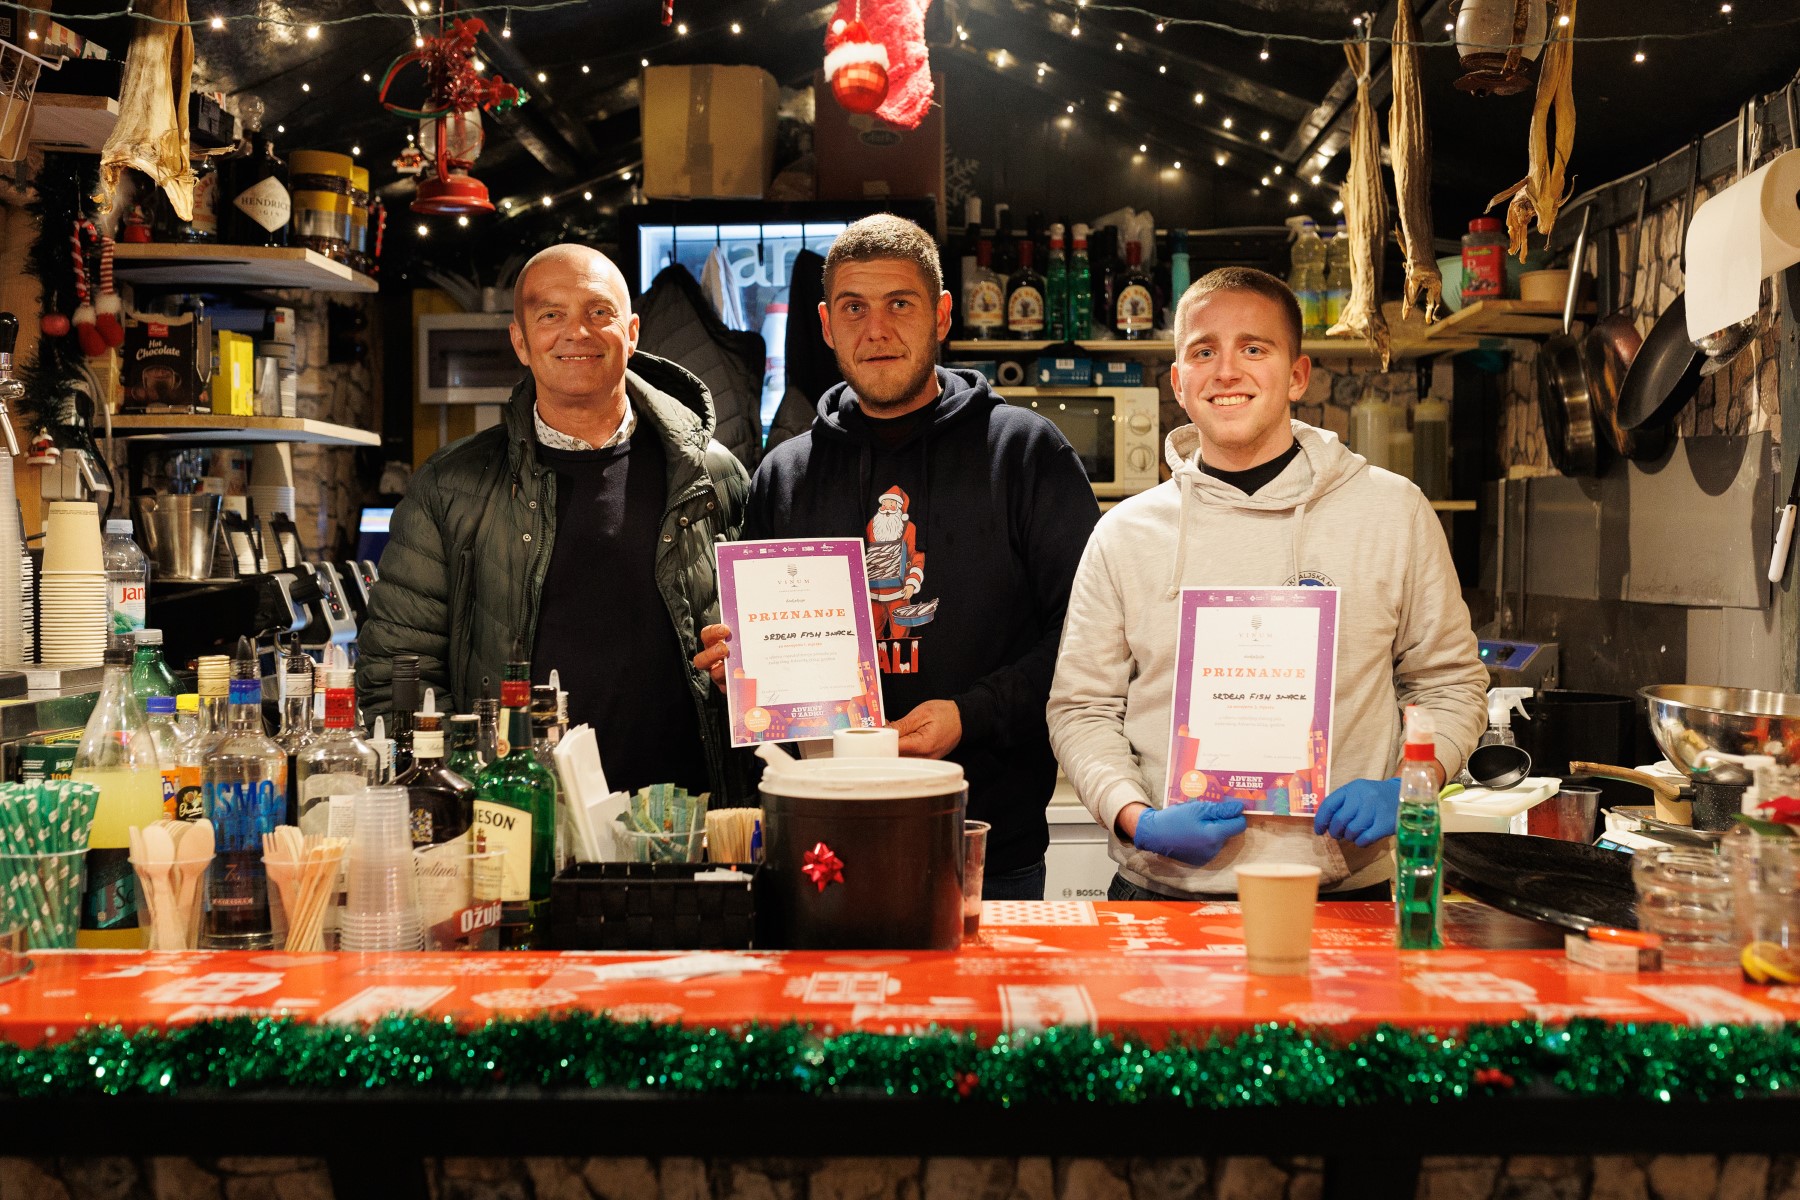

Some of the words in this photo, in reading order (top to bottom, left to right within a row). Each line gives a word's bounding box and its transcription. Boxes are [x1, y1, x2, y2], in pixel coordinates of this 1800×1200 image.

[148, 340, 162, 349] Hot
[136, 346, 180, 361] Chocolate
[748, 608, 846, 623] PRIZNANJE
[800, 631, 822, 639] FISH
[825, 629, 856, 637] SNACK
[1201, 667, 1306, 679] PRIZNANJE
[1275, 693, 1307, 701] SNACK
[791, 705, 824, 713] ADVENT
[1230, 775, 1264, 783] ADVENT
[1237, 781, 1264, 789] ZADRU
